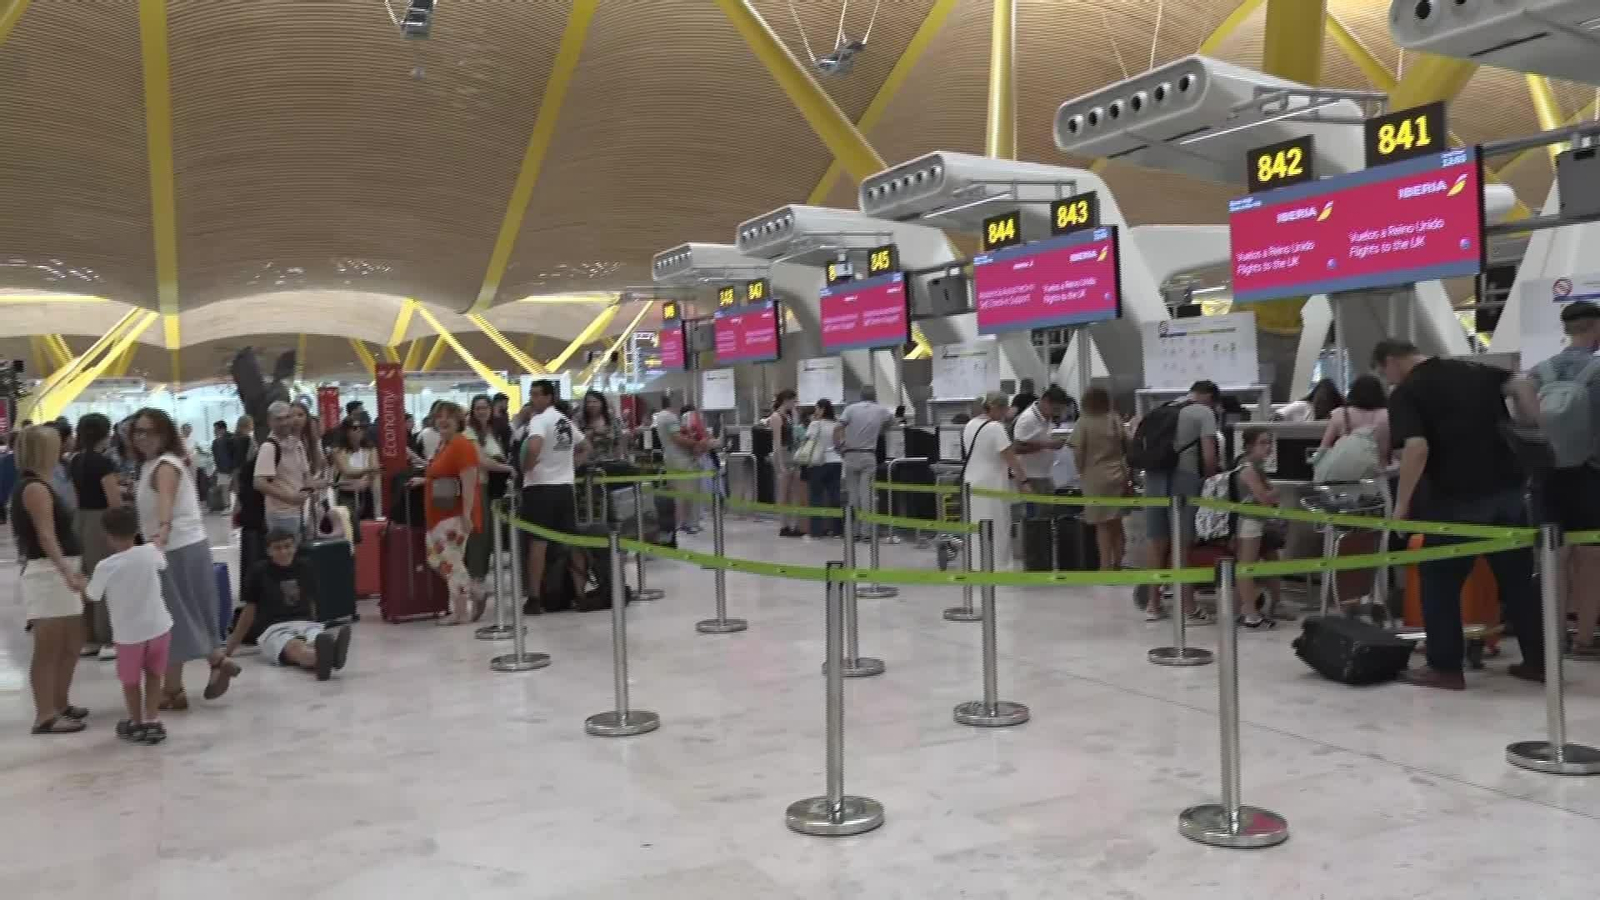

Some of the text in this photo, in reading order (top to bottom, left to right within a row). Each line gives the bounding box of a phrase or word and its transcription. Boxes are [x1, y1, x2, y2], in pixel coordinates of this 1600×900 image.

[1378, 115, 1431, 154] 841
[1257, 146, 1303, 182] 842
[1398, 180, 1447, 199] IBERIA
[1057, 200, 1089, 228] 843
[1277, 206, 1317, 223] IBERIA
[988, 218, 1015, 244] 844
[1388, 224, 1415, 237] Reino
[1416, 218, 1445, 231] Unido
[1349, 235, 1426, 259] Flights to the UK
[383, 389, 397, 457] Economy
